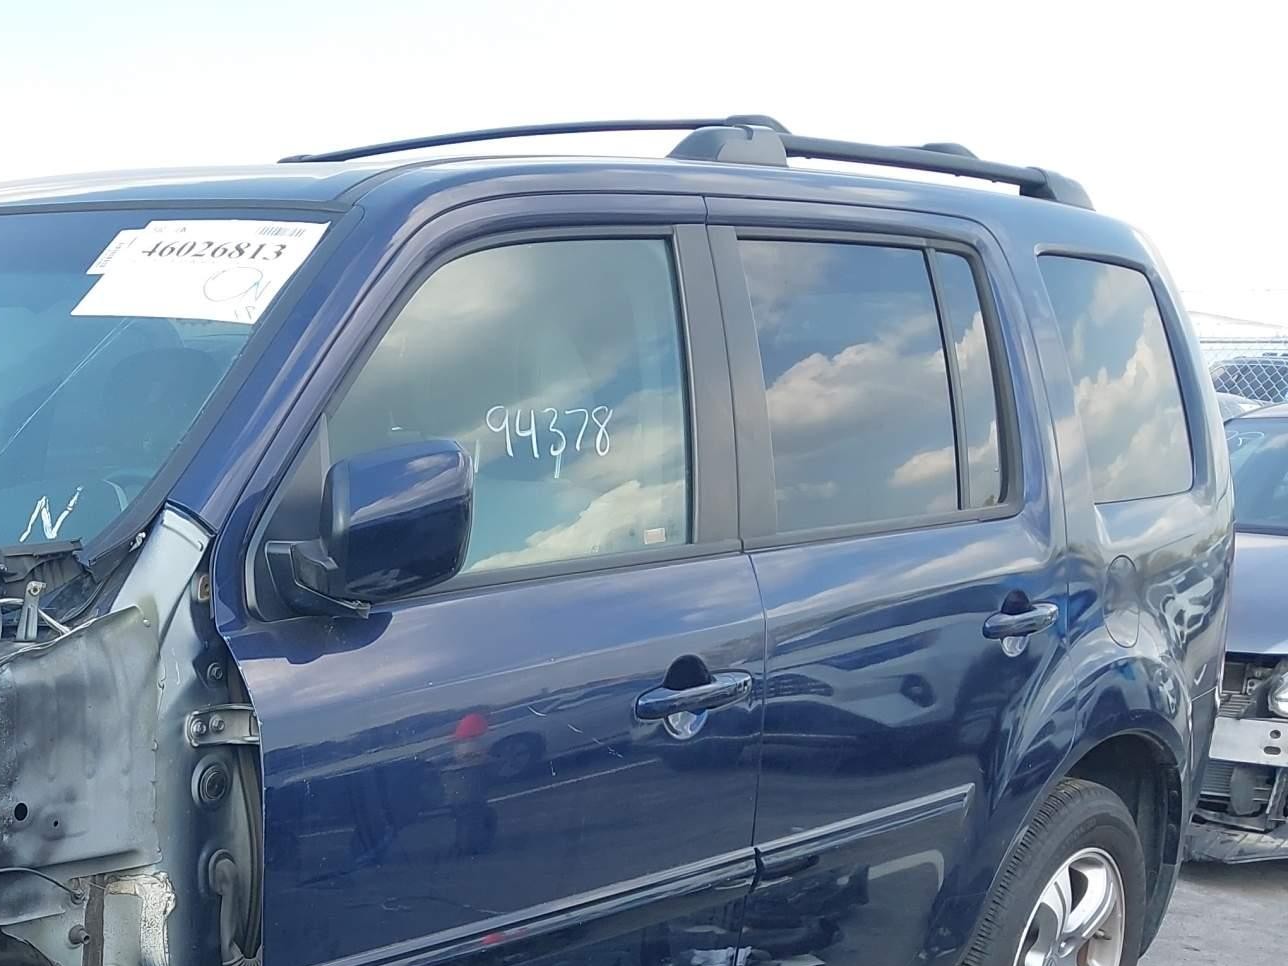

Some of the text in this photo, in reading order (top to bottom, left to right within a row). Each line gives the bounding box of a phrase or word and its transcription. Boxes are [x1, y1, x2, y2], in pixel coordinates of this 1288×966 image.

[141, 240, 287, 261] 46026813
[485, 404, 614, 460] 94378
[19, 486, 84, 542] N
